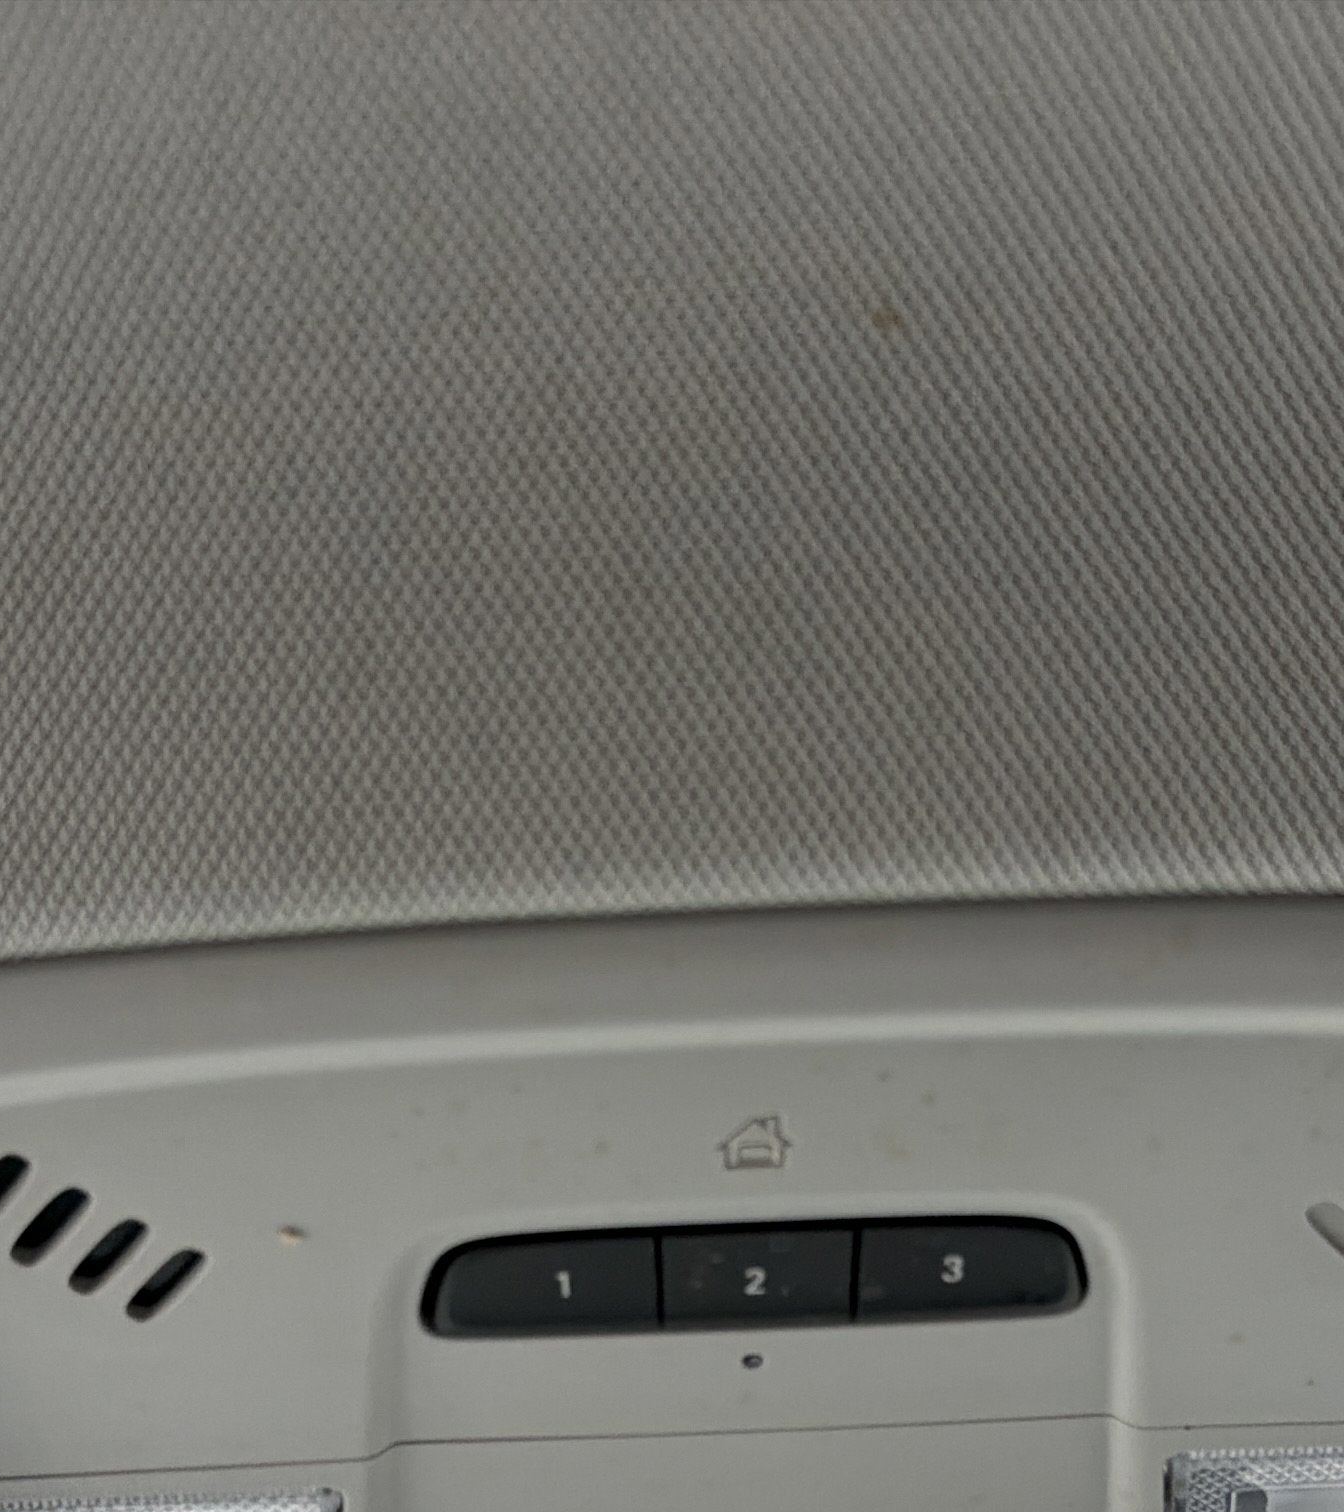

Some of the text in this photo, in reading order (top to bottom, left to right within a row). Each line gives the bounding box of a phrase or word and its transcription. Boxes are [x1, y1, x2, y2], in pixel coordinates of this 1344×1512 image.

[745, 1267, 765, 1295] 2
[941, 1255, 964, 1283] 3
[556, 1270, 572, 1298] 1
